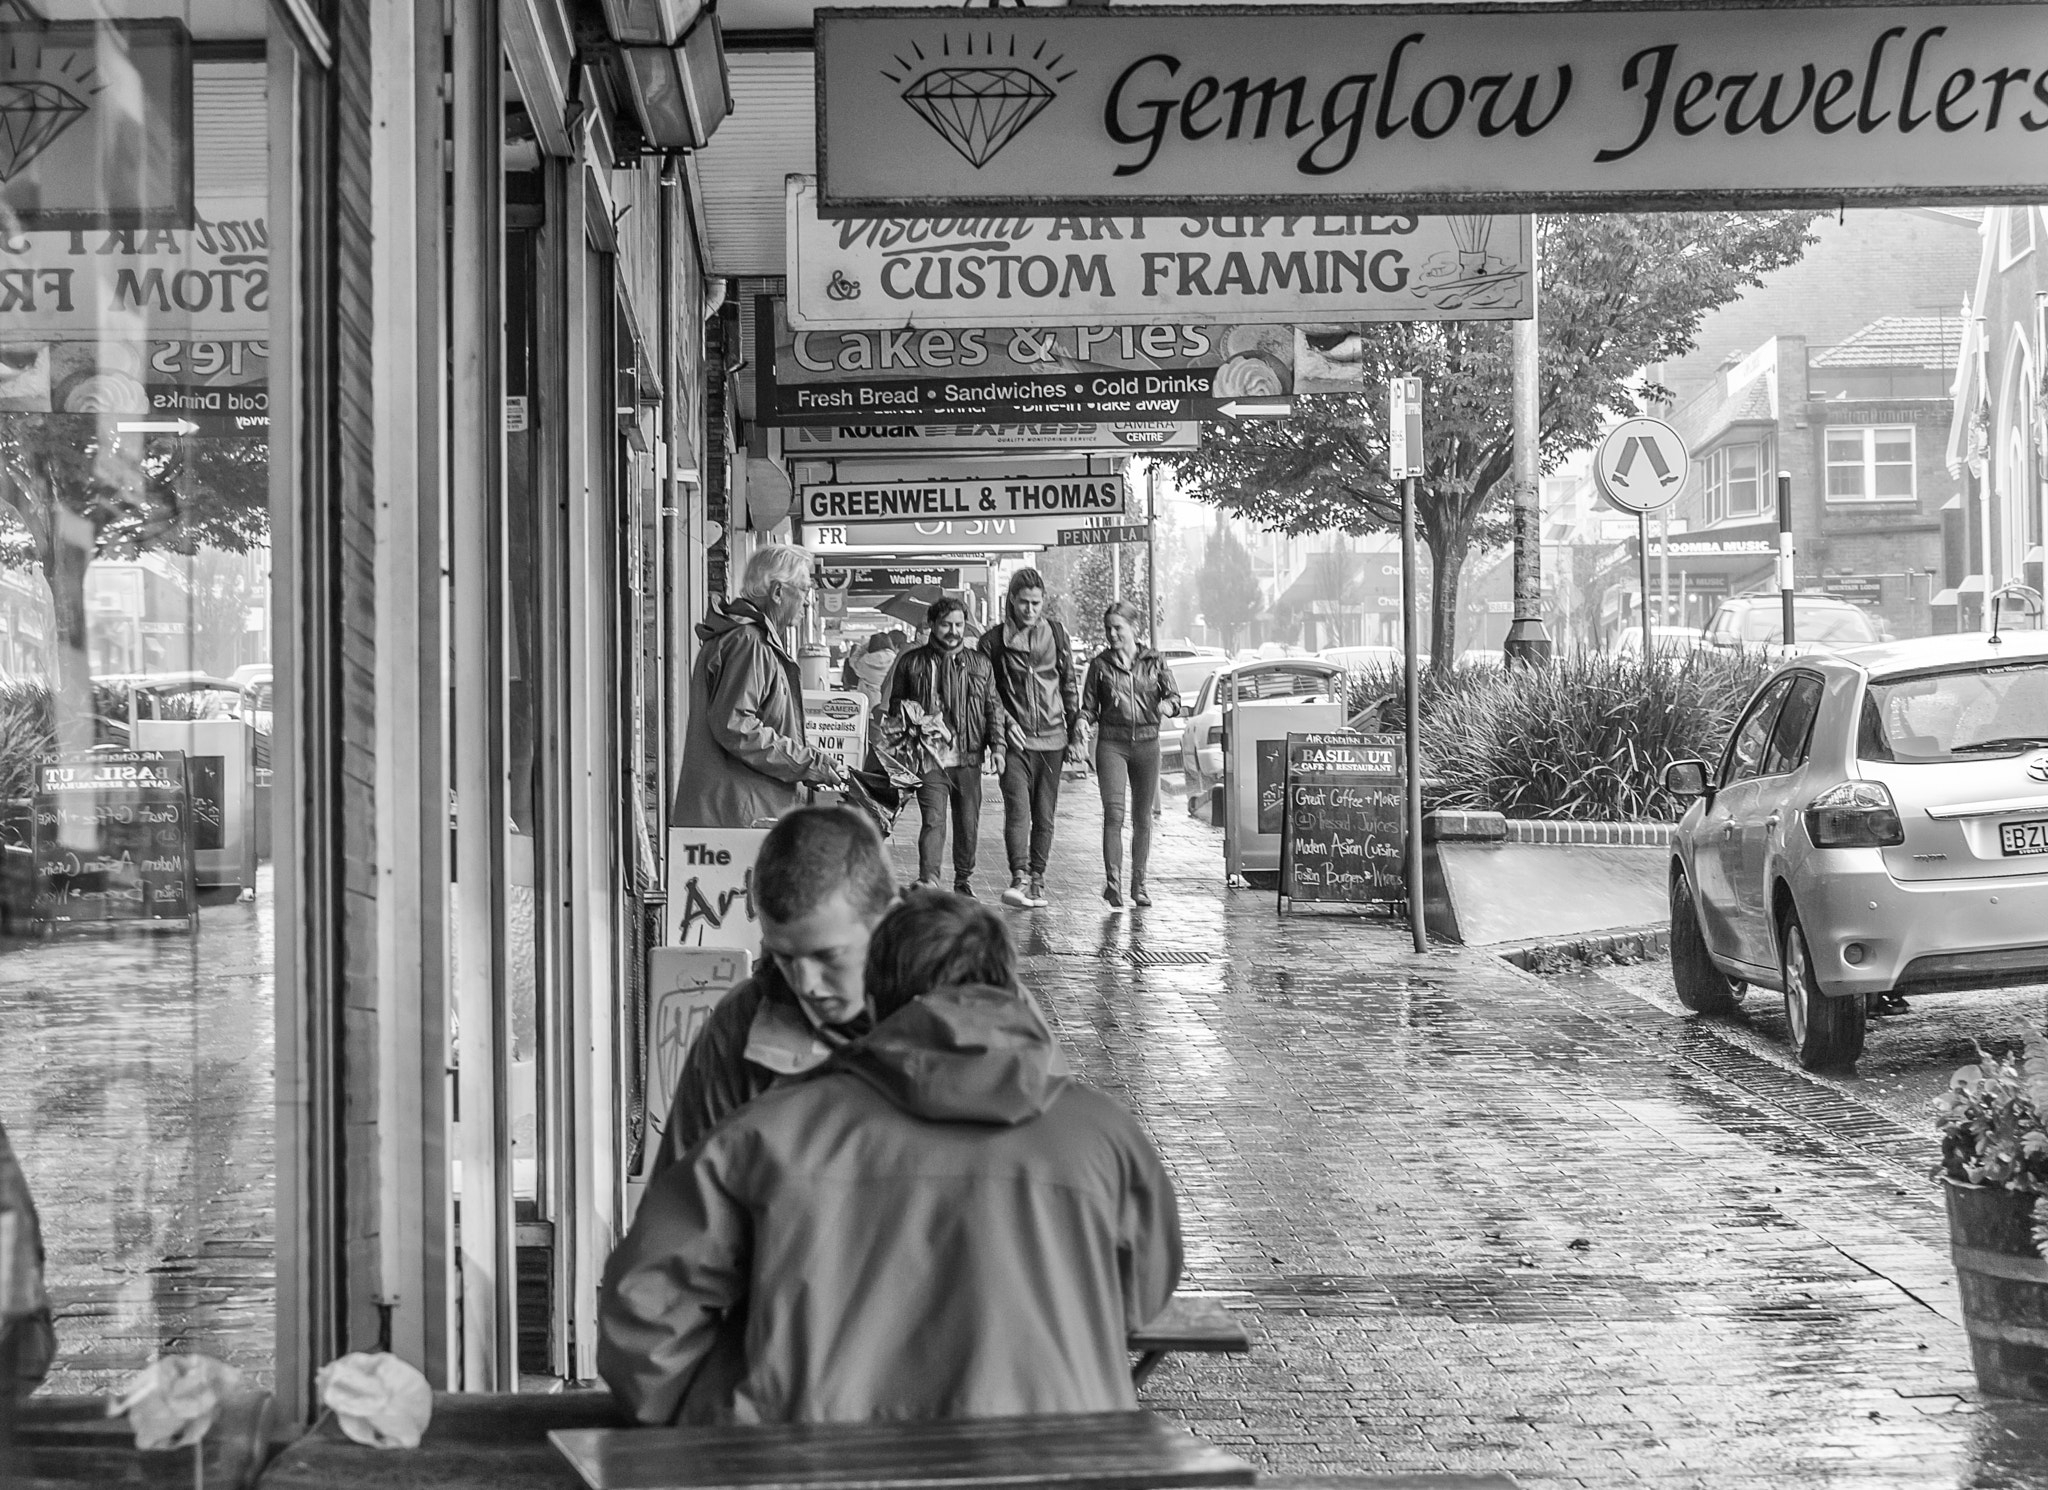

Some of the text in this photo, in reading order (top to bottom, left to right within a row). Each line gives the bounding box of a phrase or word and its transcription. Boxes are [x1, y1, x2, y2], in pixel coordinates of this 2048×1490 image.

[1104, 26, 2048, 176] Gemglow Jewellers
[826, 249, 1410, 301] & CUSTOM FRAMING
[793, 324, 1211, 373] Cakes & Pies
[798, 375, 1210, 408] Fresh Bread Sandwiches Cold Drinks
[1135, 399, 1180, 414] away
[838, 424, 920, 438] Kodak
[1126, 432, 1164, 442] CENTRE
[810, 482, 1117, 517] GREENWELL & THOMAS
[819, 527, 847, 544] FR
[1063, 527, 1138, 545] PENNY LA
[1722, 540, 1770, 552] MUSIC
[889, 574, 943, 585] Waffle Bar
[823, 704, 860, 713] CAMERA
[818, 721, 856, 732] specialists
[818, 736, 845, 750] NOW
[1301, 762, 1325, 771] CAFE
[1335, 763, 1393, 772] RESTAURANT
[1295, 787, 1327, 806] Great
[1330, 788, 1363, 809] Coffee
[1330, 832, 1363, 858] Asian
[1364, 833, 1401, 859] Cuisine
[683, 842, 732, 867] The
